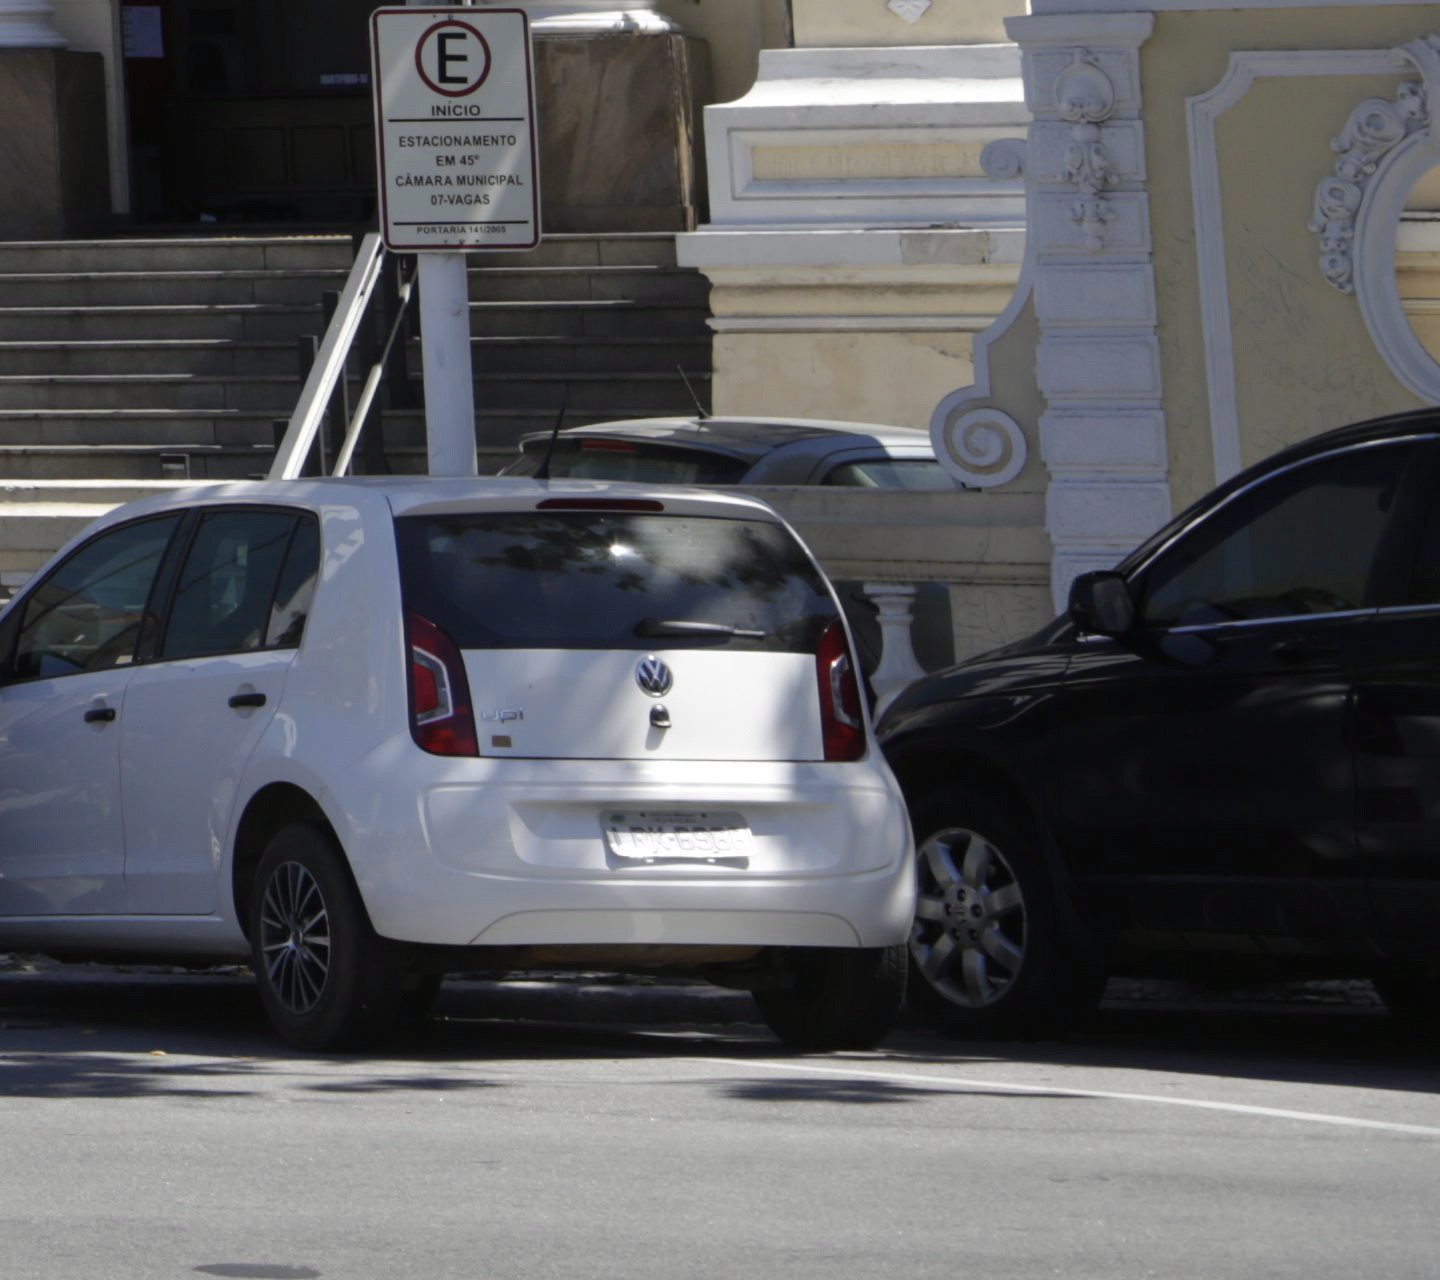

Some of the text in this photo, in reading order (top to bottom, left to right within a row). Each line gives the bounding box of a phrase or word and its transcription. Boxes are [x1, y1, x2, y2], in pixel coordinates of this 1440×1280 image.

[437, 32, 468, 84] E
[431, 100, 481, 116] INÍCIO
[398, 135, 517, 148] ESTACIONAMENTO
[435, 155, 455, 166] EM
[395, 173, 524, 187] CÂMARA MUNICIPAL
[430, 194, 491, 206] 07-VAGAS
[416, 225, 467, 235] PORTARIA
